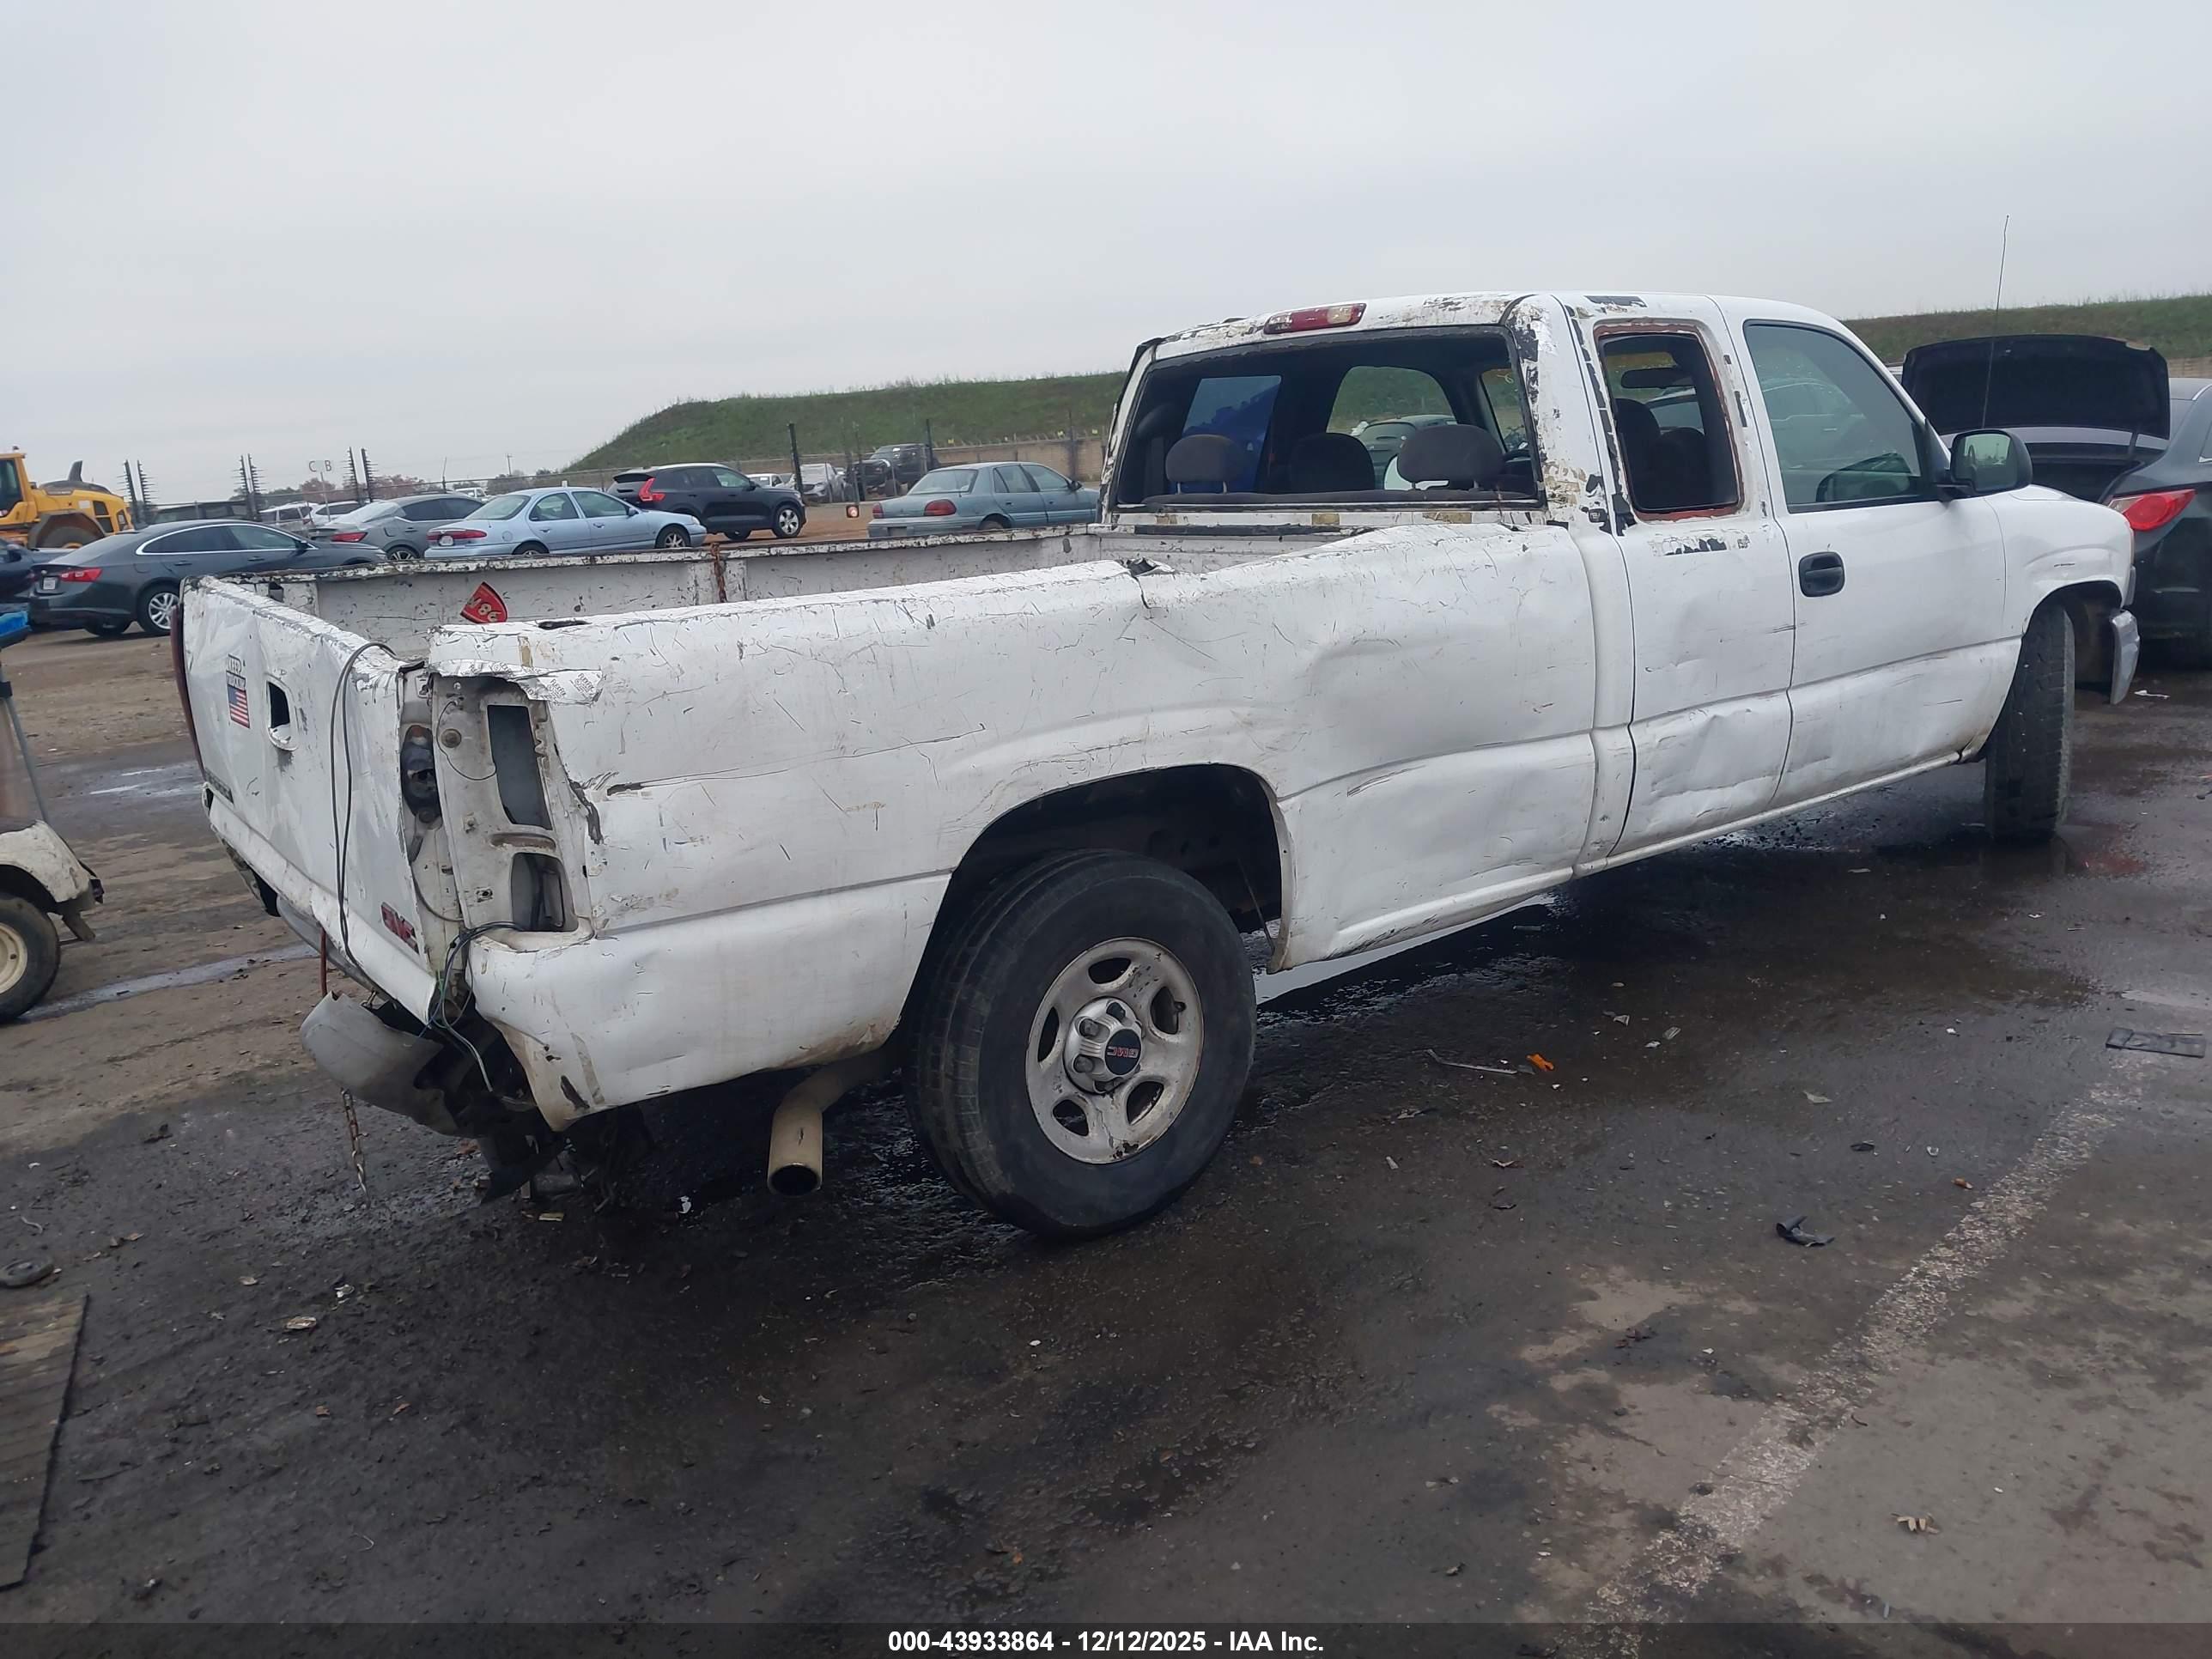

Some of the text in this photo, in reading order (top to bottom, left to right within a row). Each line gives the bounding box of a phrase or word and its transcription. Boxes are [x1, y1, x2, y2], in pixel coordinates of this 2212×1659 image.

[308, 459, 332, 472] C B
[1107, 1046, 1139, 1059] GMC
